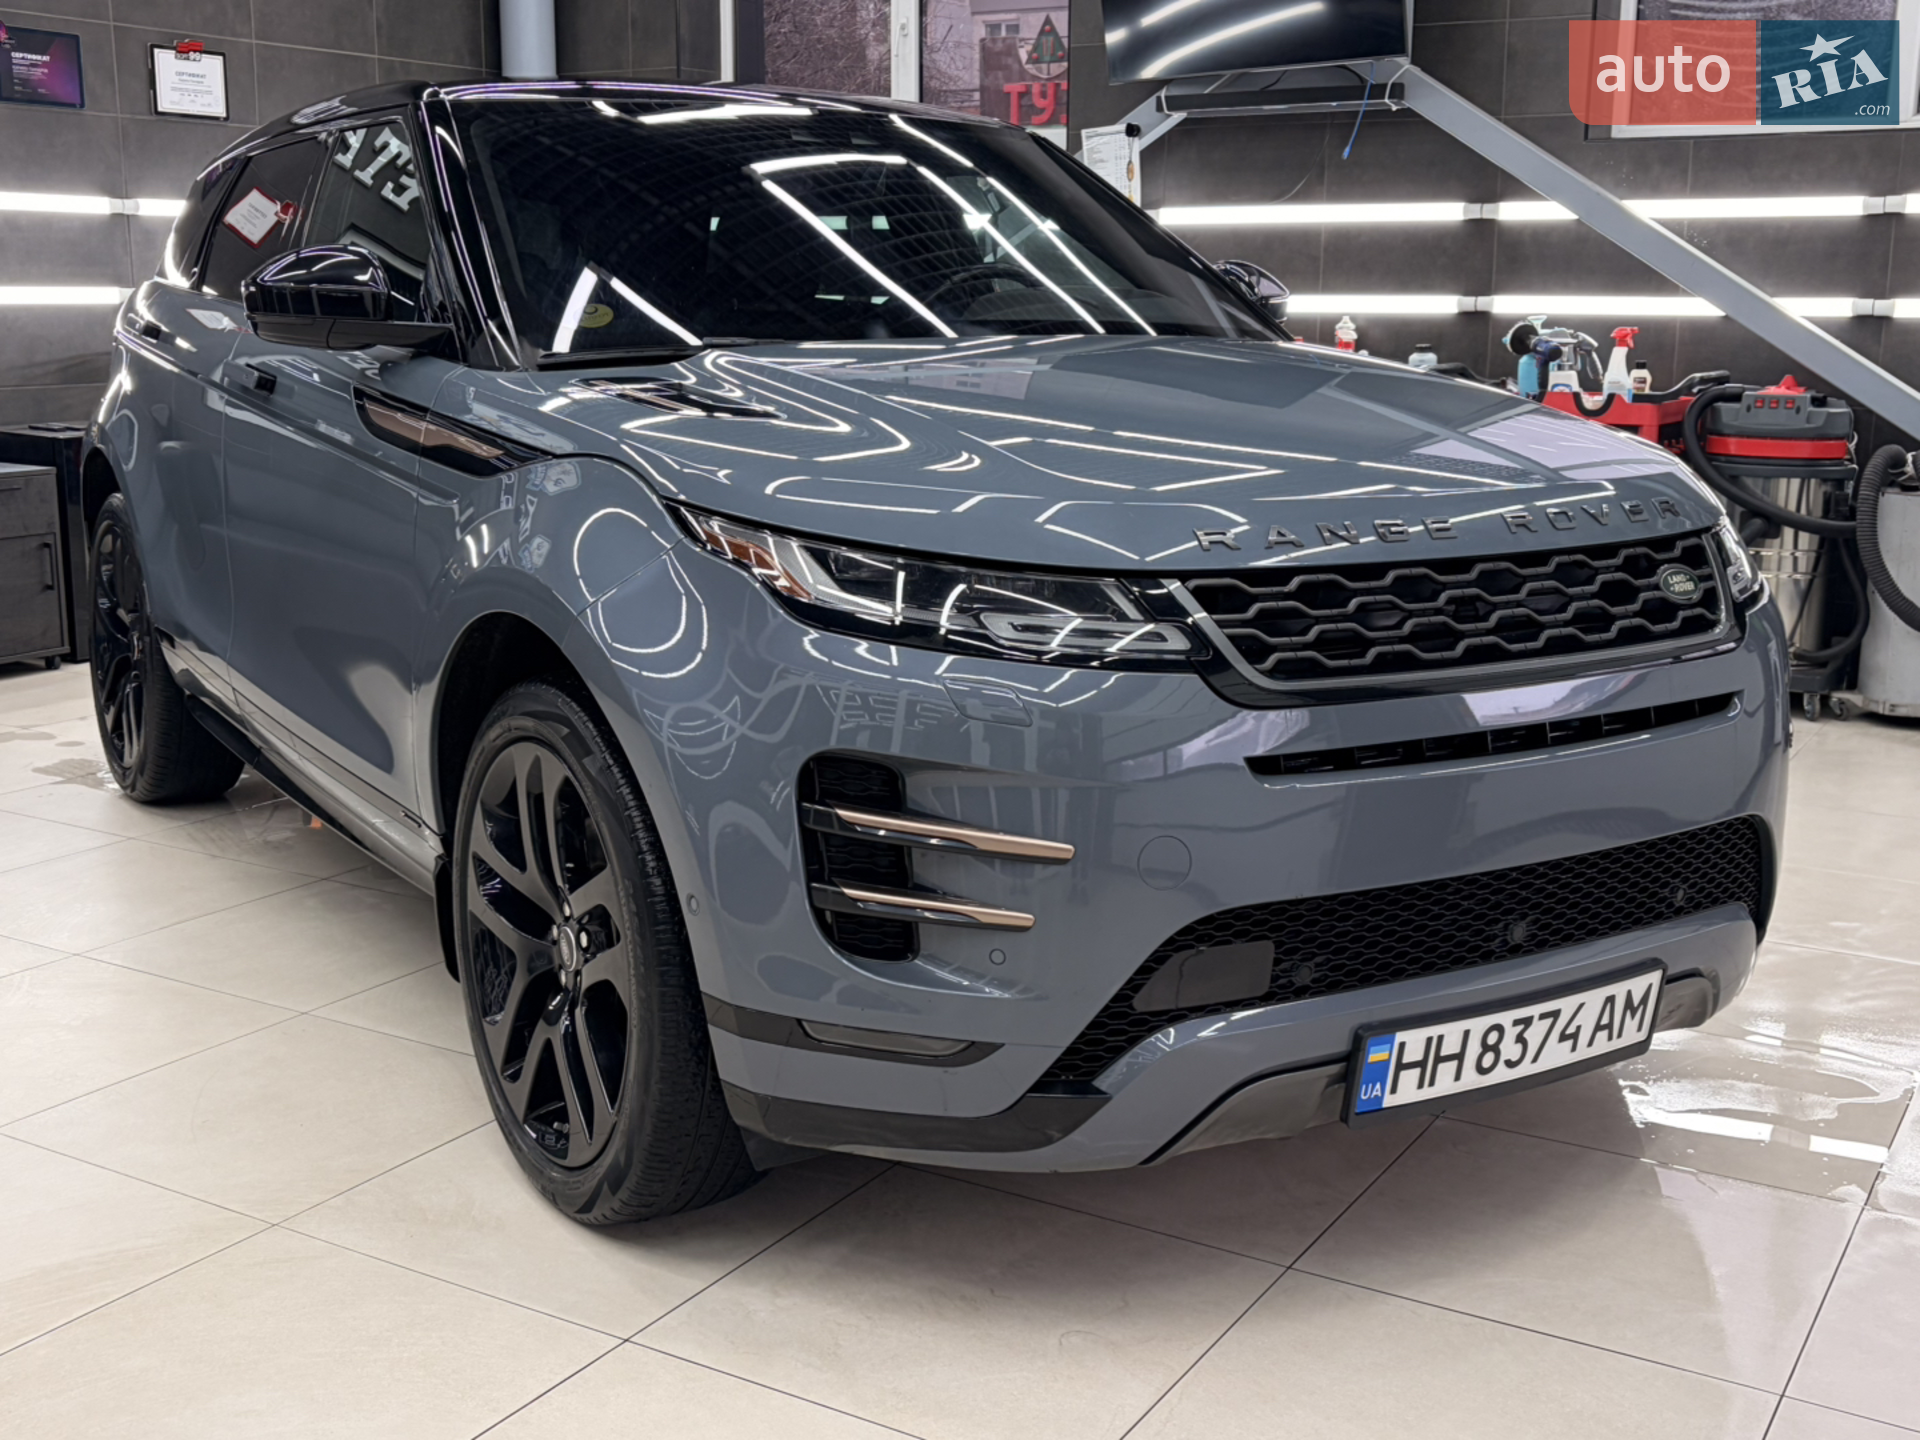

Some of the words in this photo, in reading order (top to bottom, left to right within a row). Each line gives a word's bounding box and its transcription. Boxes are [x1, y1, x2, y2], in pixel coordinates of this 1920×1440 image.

[1193, 516, 1458, 551] RANGE
[1501, 497, 1681, 534] ROVER
[1667, 573, 1687, 584] LAND
[1674, 580, 1696, 593] ROVER
[1360, 1083, 1382, 1100] UA
